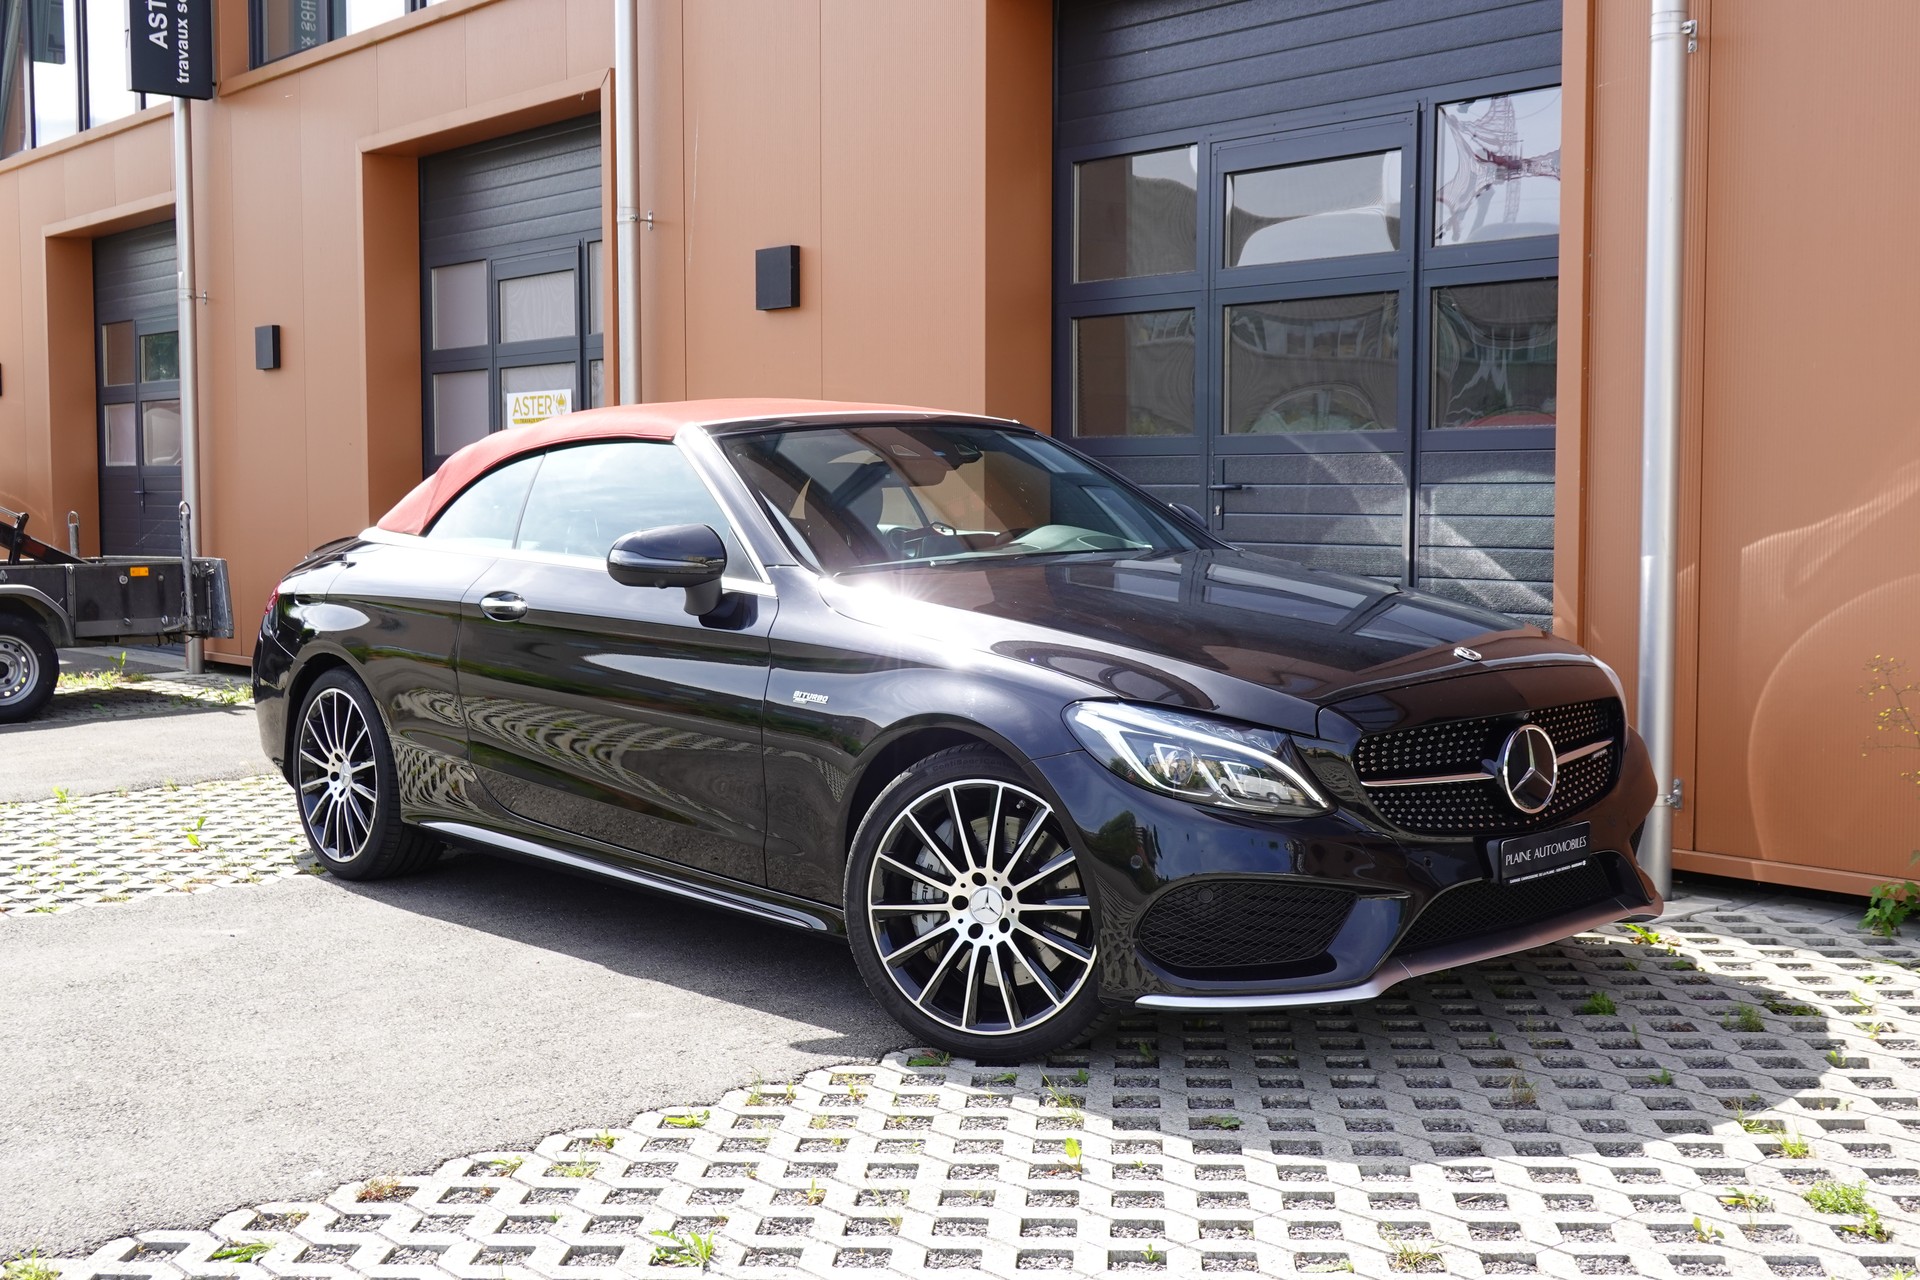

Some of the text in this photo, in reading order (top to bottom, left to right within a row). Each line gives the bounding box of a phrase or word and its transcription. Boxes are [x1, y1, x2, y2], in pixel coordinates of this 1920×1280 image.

[176, 18, 190, 84] travaux
[793, 690, 829, 704] BITURBO
[1505, 835, 1587, 866] PLAINE AUTOMOBILES
